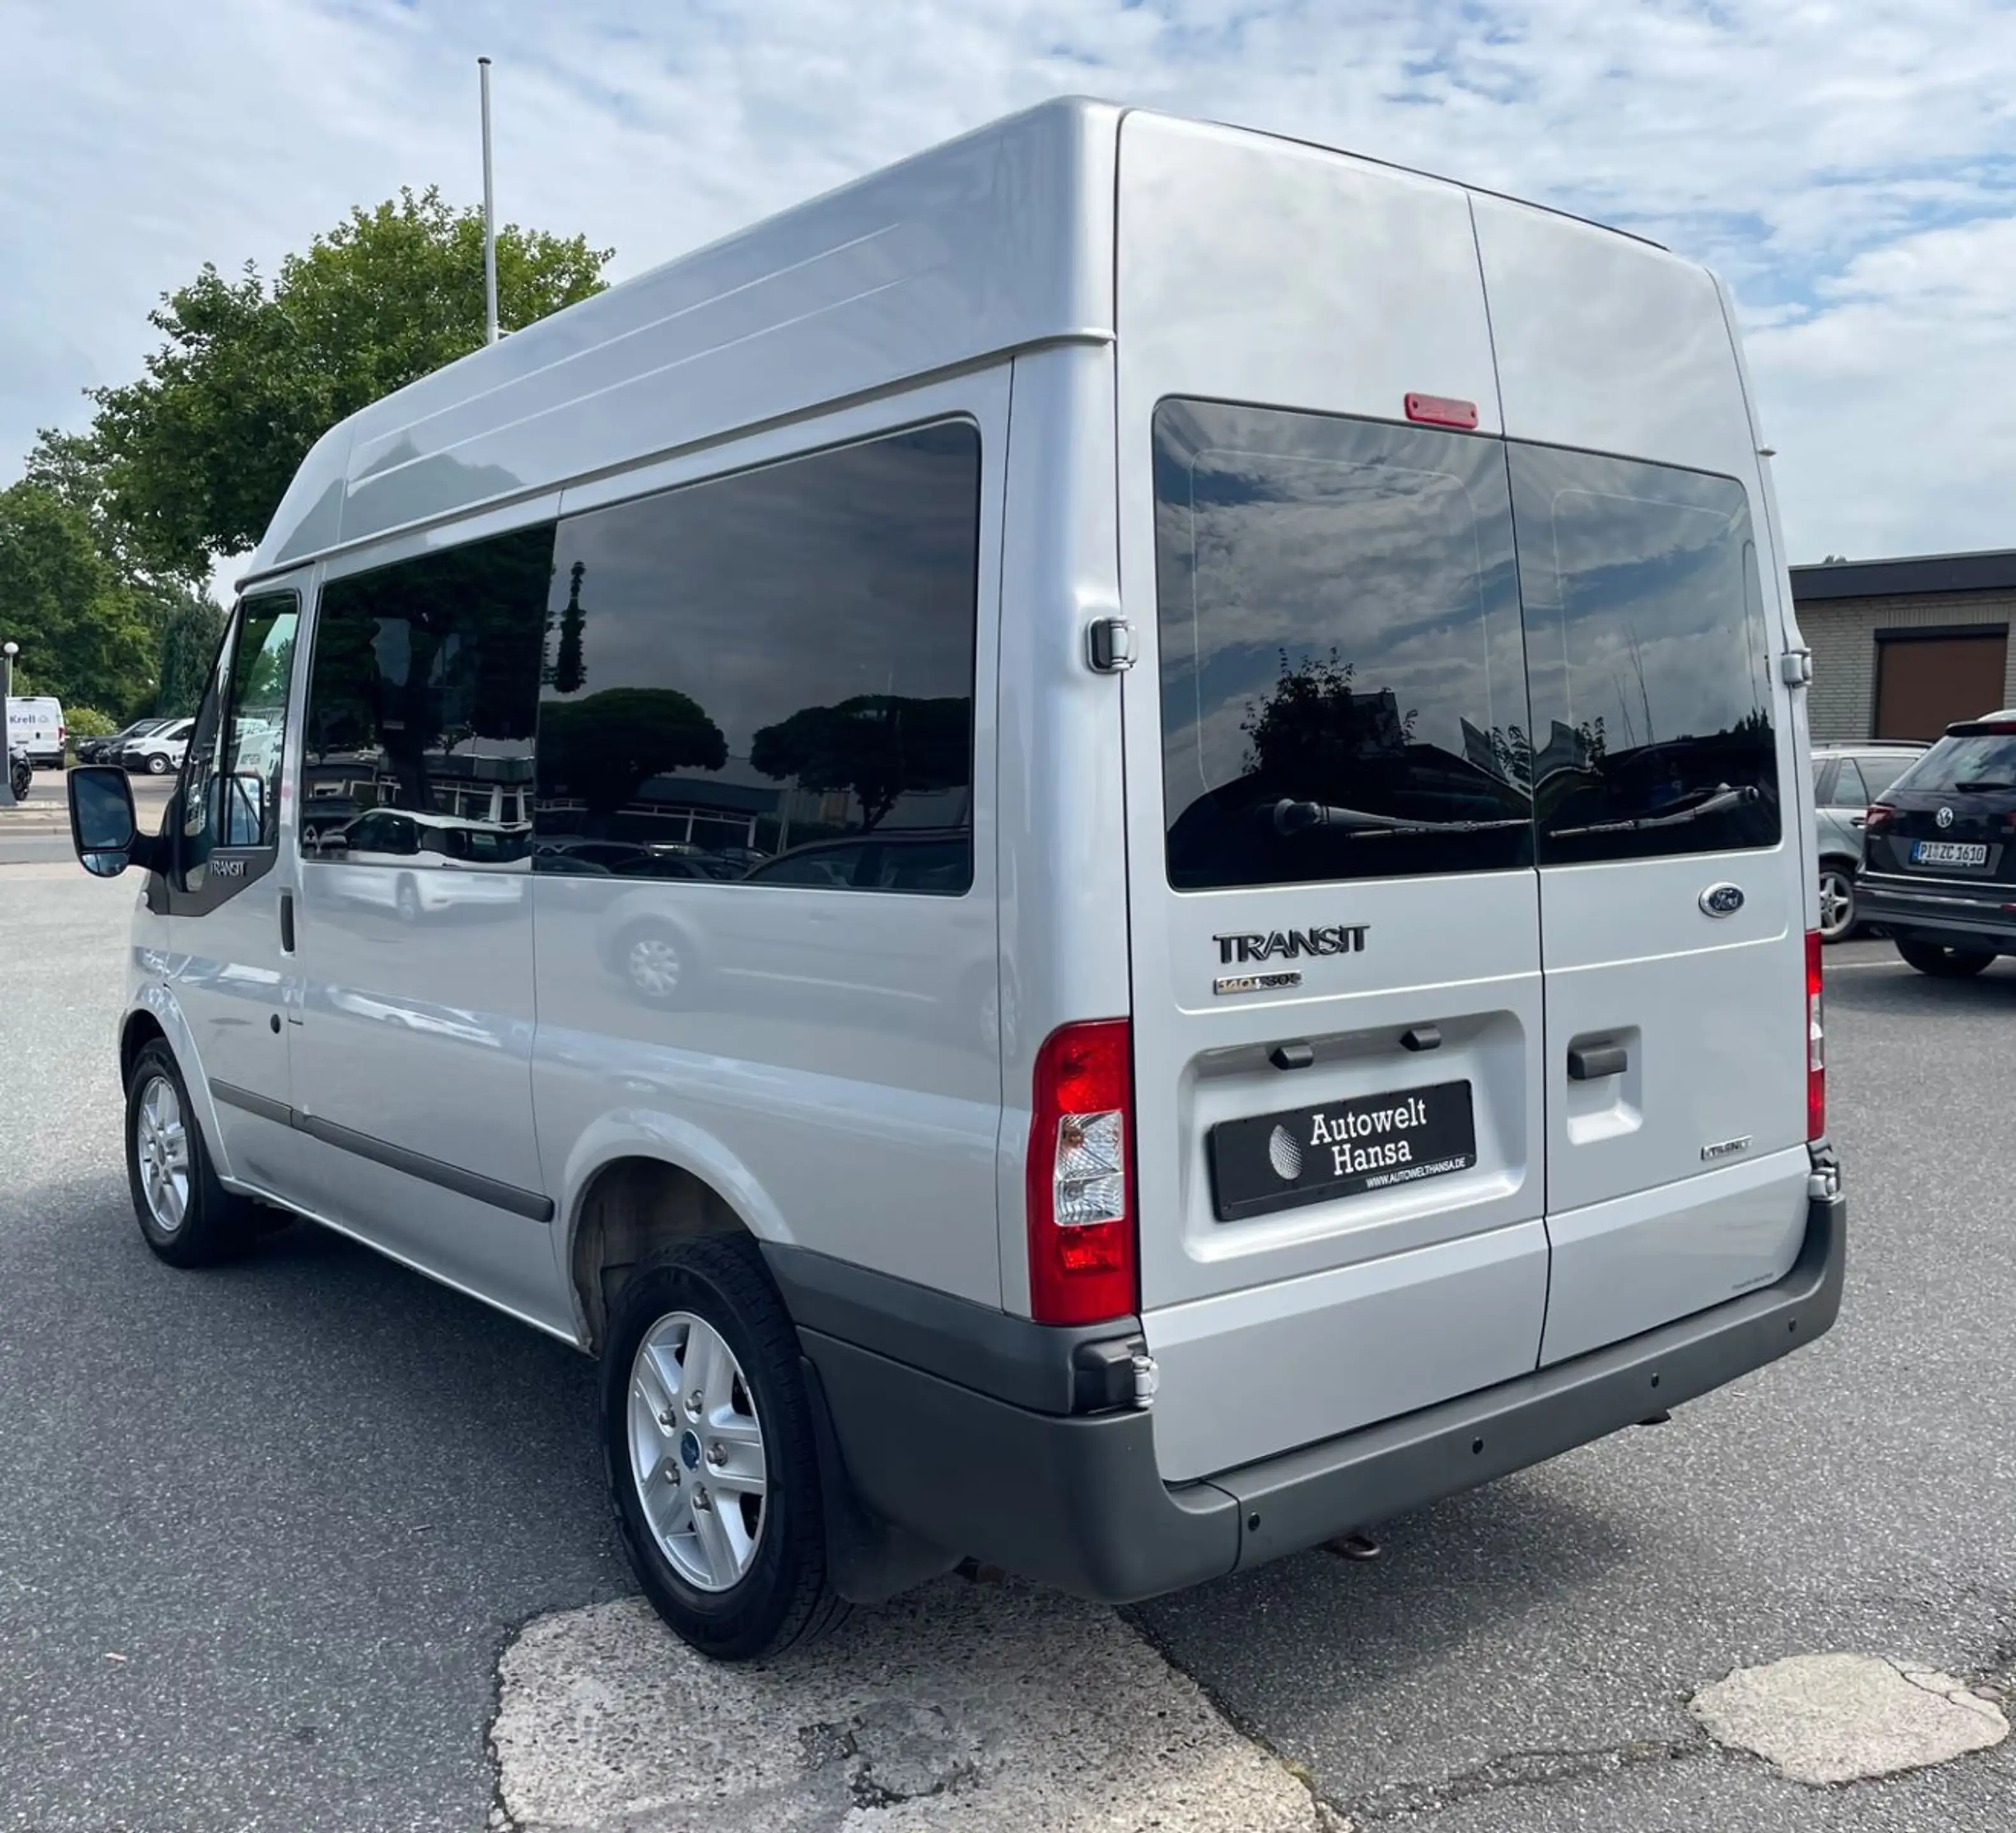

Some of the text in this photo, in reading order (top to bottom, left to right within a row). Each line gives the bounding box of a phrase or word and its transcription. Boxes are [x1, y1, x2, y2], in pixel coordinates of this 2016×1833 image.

[10, 714, 36, 724] Krell
[1921, 844, 1933, 858] PI
[1939, 845, 1954, 859] ZC
[1956, 846, 1984, 861] 1610
[1213, 925, 1371, 964] TRANSIT
[1310, 1097, 1427, 1146] Autowelt
[1332, 1140, 1412, 1176] Hansa
[1366, 1157, 1466, 1188] WWW.AUTOWELTHANSA.DE
